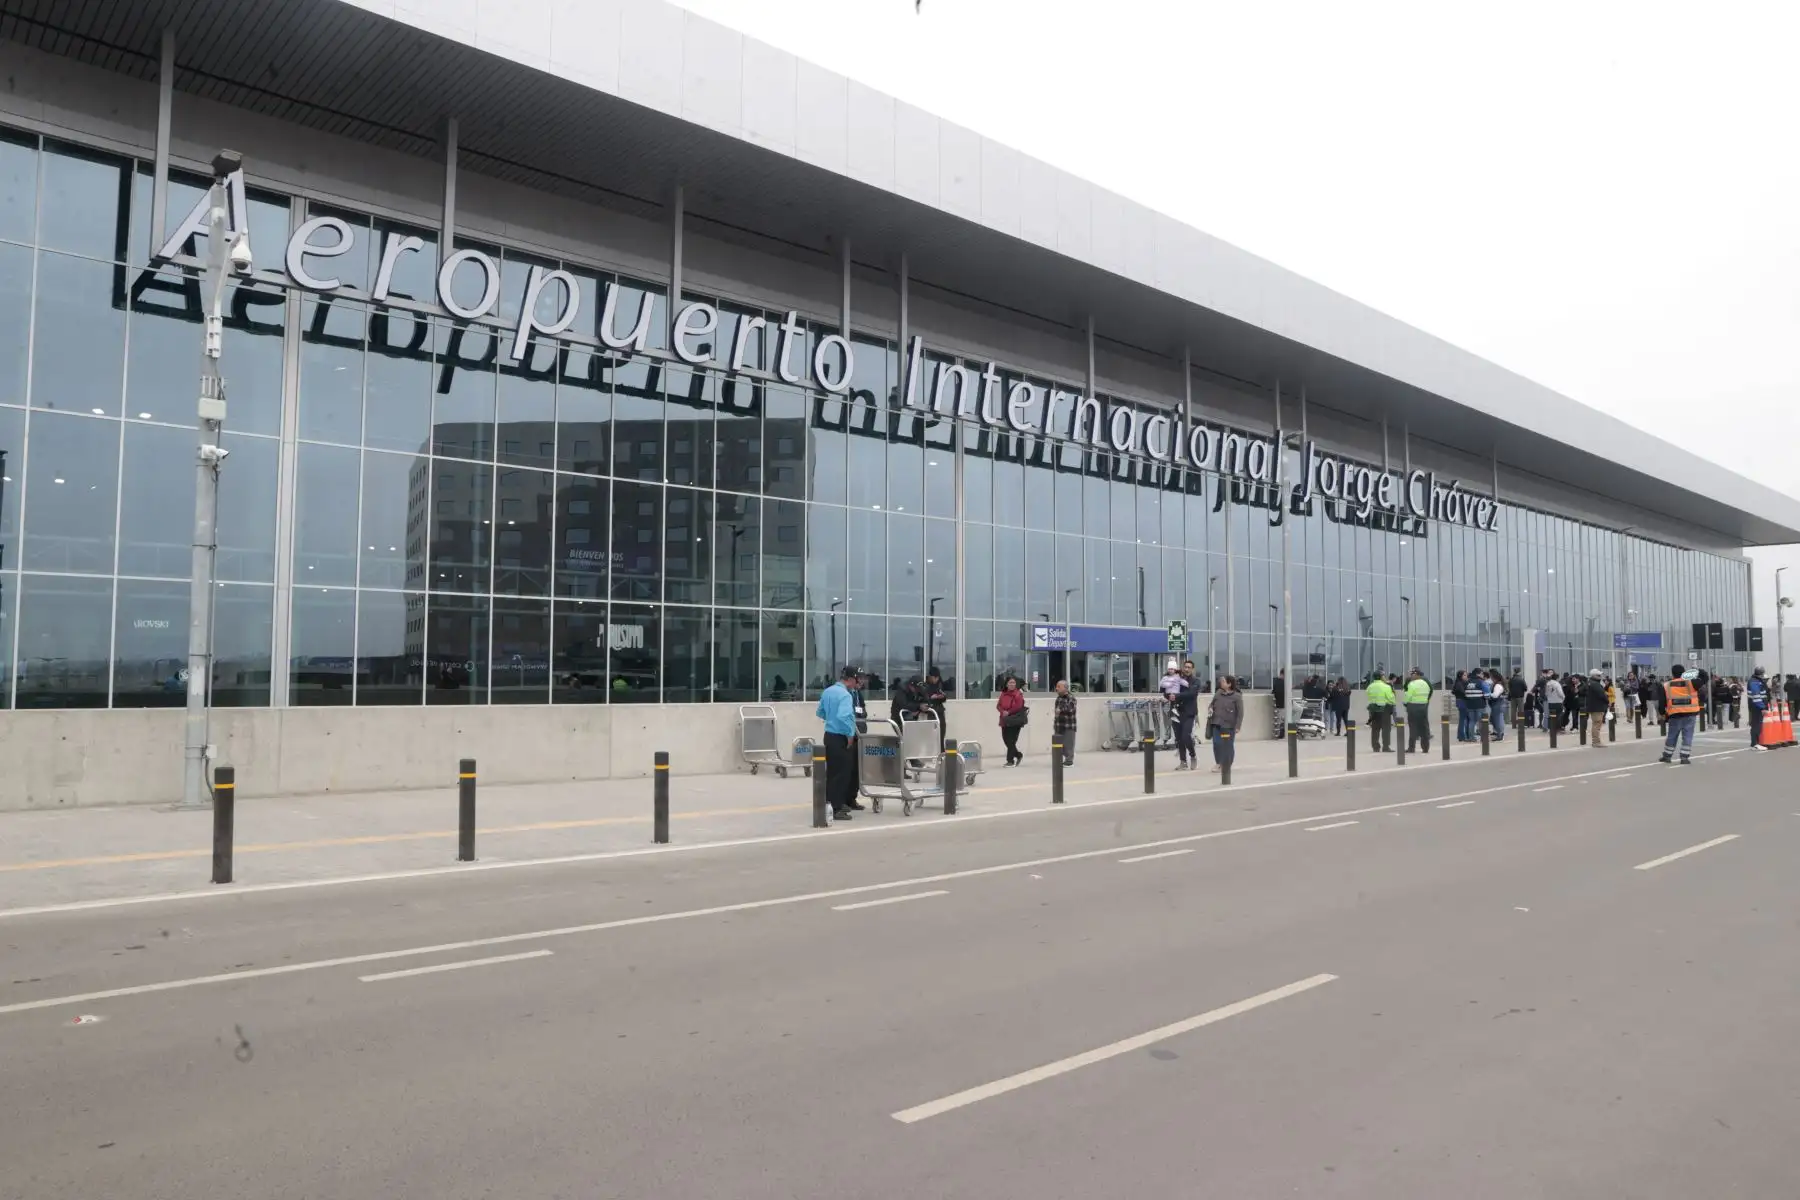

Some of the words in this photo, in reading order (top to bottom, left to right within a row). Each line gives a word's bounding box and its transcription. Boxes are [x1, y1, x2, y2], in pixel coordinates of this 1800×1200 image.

[156, 167, 854, 392] Aeropuerto
[903, 335, 1284, 484] Internacional
[1301, 440, 1392, 519] Jorge
[1407, 469, 1500, 531] Chávez
[569, 548, 624, 562] BIENVENOS
[1049, 637, 1078, 648] Departres
